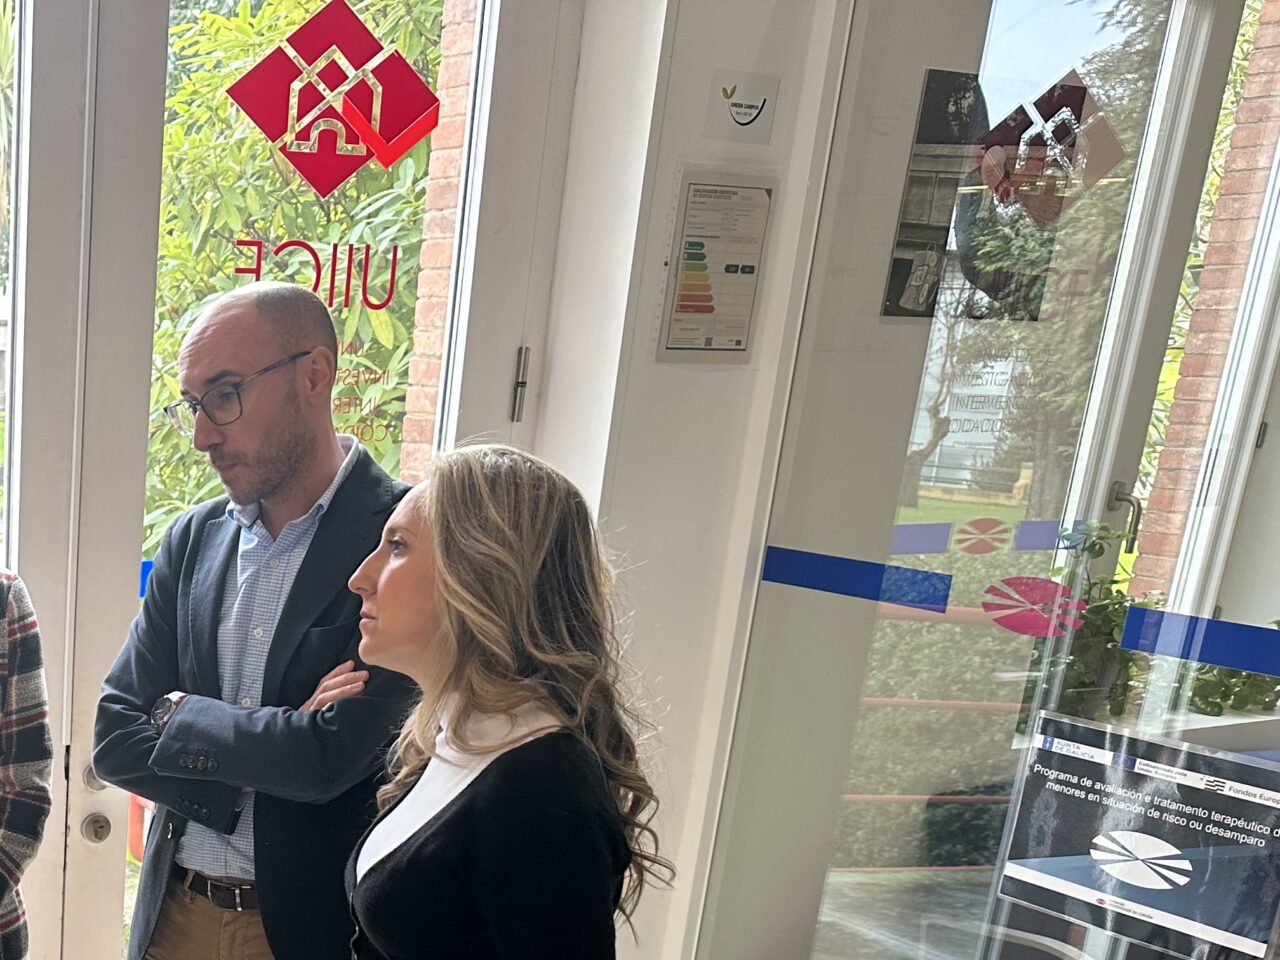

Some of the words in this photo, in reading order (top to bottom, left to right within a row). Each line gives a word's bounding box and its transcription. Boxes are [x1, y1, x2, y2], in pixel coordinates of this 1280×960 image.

[1056, 740, 1081, 750] XUNTA
[1066, 748, 1095, 760] GALICIA
[1033, 763, 1079, 784] Programa
[1080, 777, 1093, 788] de
[1094, 780, 1143, 801] avaliación
[1144, 795, 1152, 803] e
[1153, 795, 1209, 818] tratamento
[1210, 811, 1271, 835] terapéutico
[1228, 785, 1258, 799] Fondos
[1045, 781, 1086, 799] menores
[1087, 793, 1100, 803] en
[1101, 797, 1145, 815] situación
[1147, 807, 1160, 819] de
[1162, 811, 1187, 826] risco
[1189, 820, 1203, 831] ou
[1205, 823, 1266, 847] desamparo
